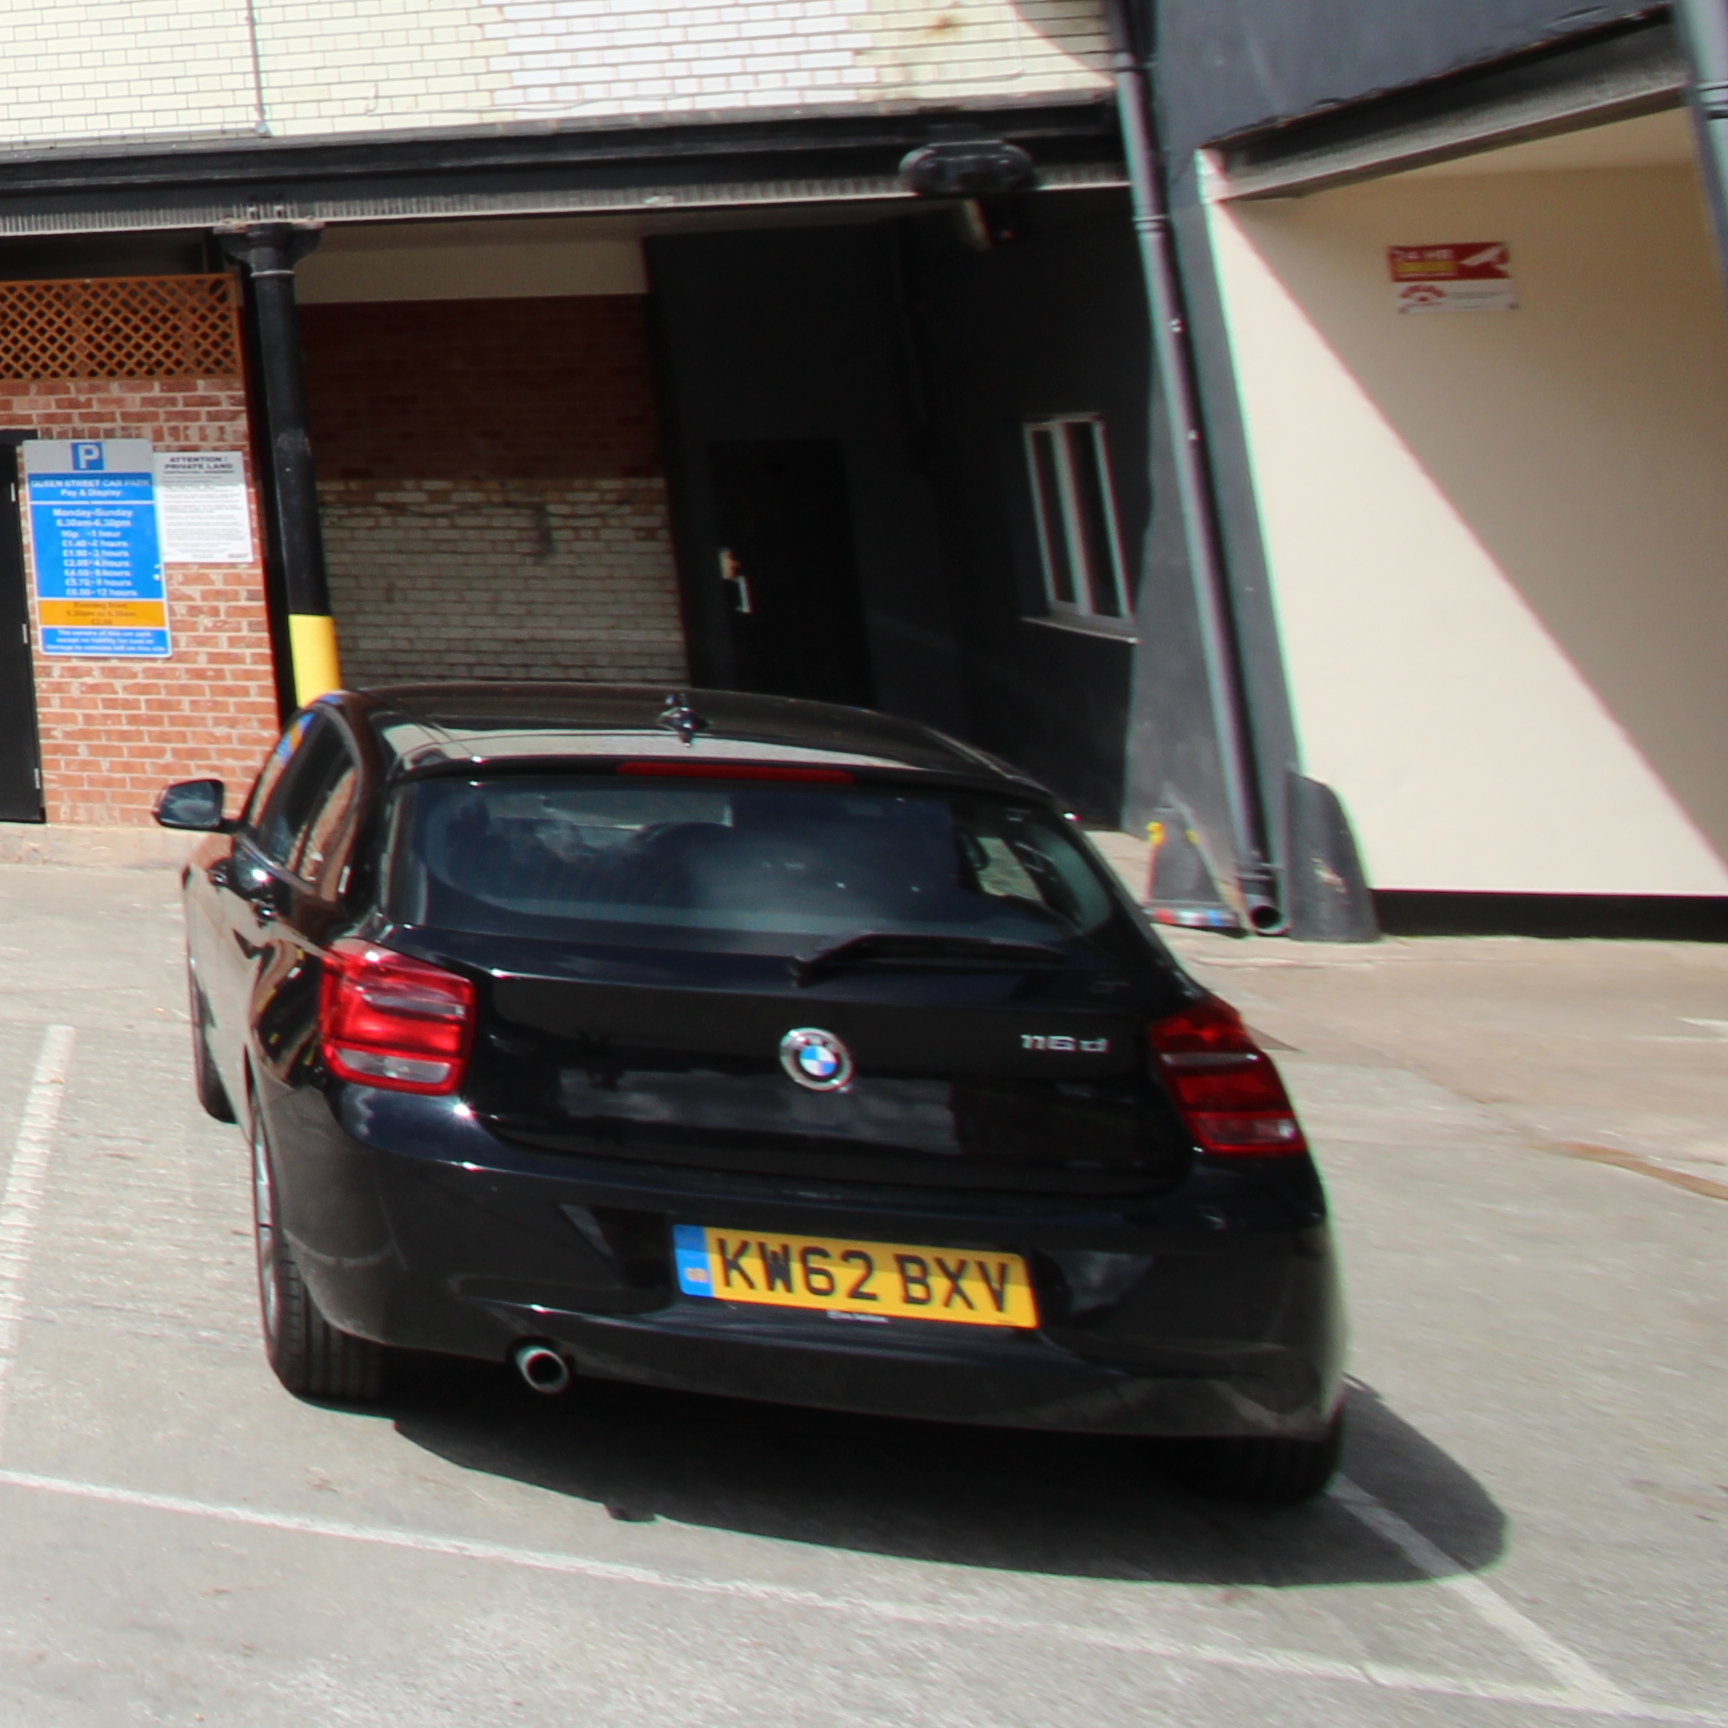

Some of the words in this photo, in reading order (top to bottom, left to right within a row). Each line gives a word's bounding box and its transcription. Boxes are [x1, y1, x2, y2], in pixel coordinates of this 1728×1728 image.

[77, 444, 101, 469] P
[30, 479, 64, 488] QUEEN
[64, 479, 101, 488] STREET
[102, 479, 123, 487] CAR
[124, 479, 150, 487] PARK
[60, 489, 77, 498] Pay
[88, 489, 123, 498] Display
[716, 1236, 880, 1301] KW62
[894, 1252, 1010, 1313] BXV
